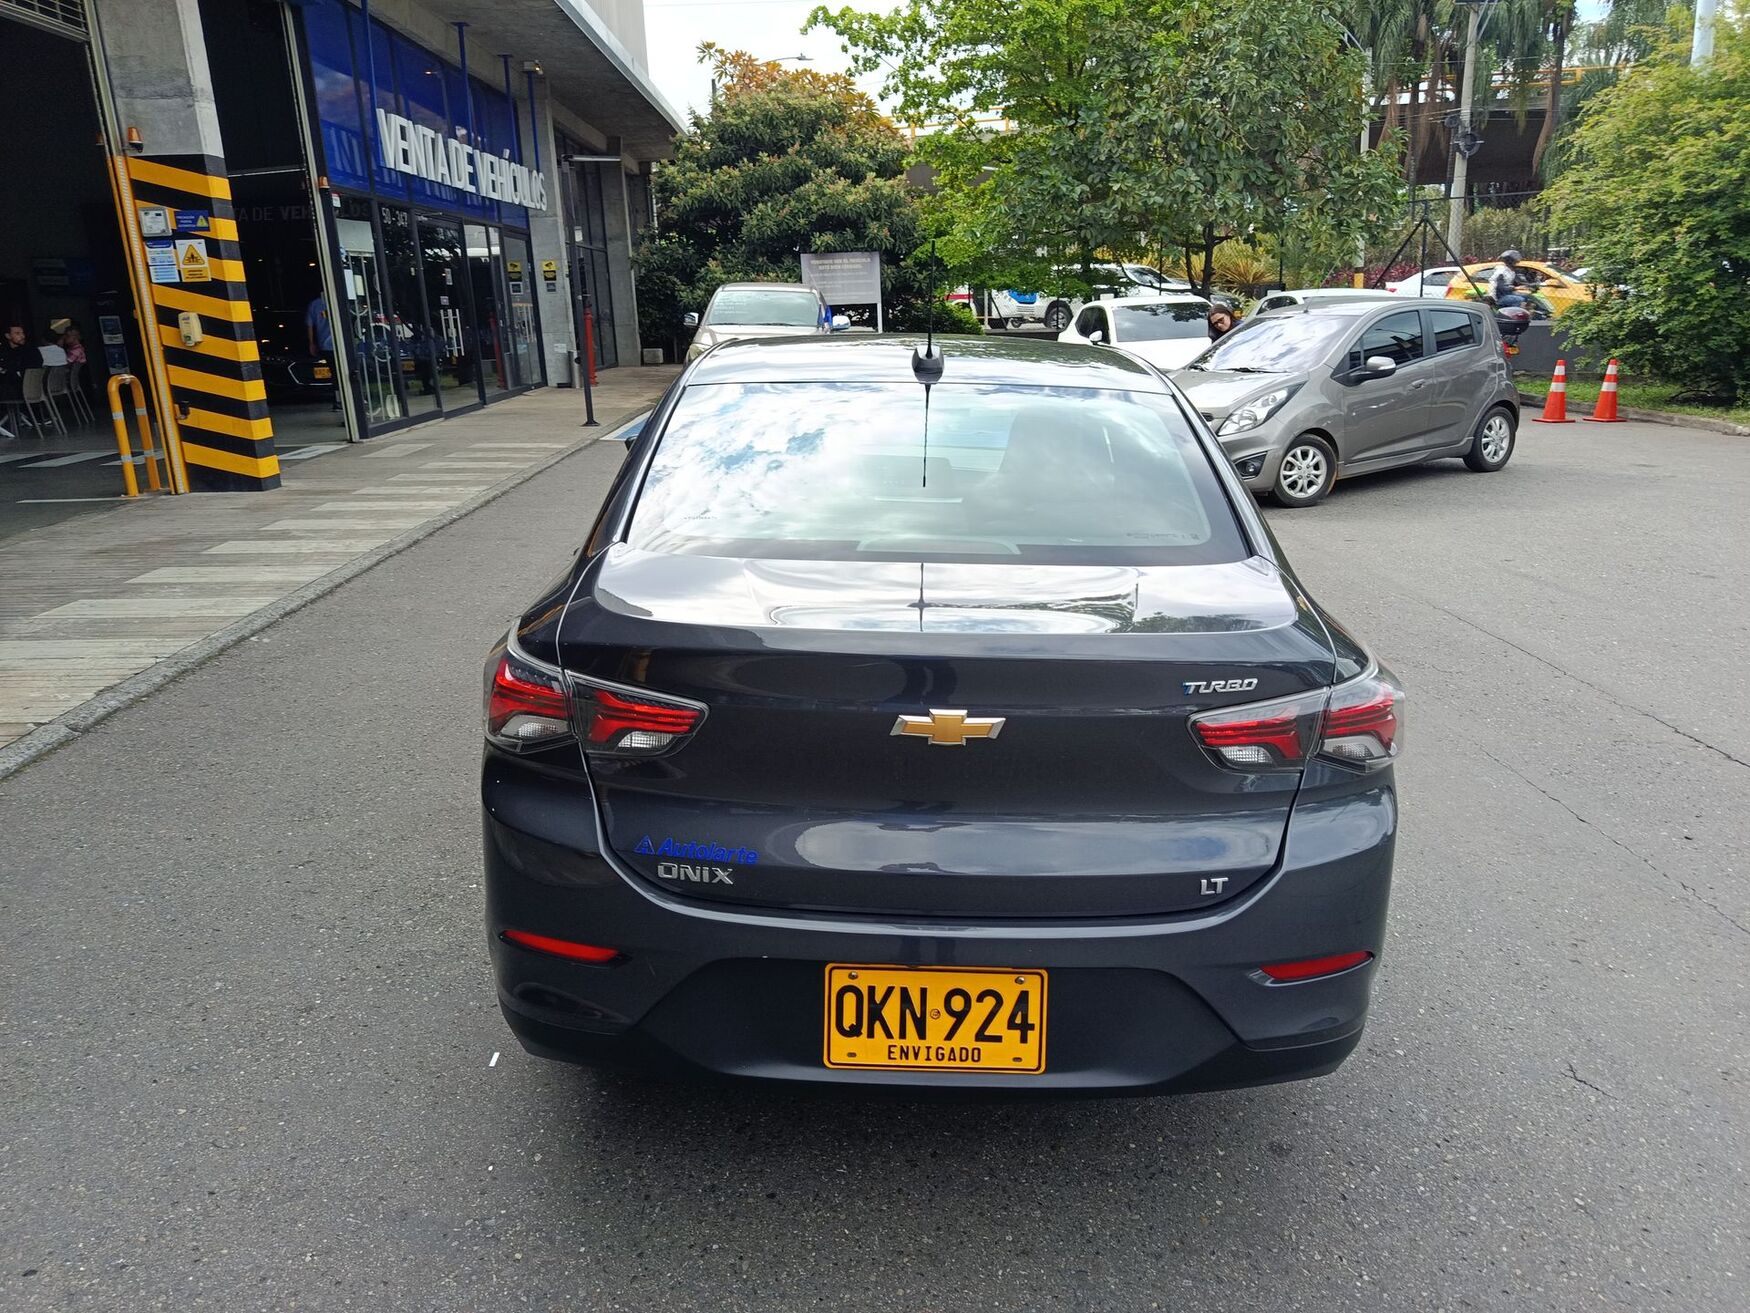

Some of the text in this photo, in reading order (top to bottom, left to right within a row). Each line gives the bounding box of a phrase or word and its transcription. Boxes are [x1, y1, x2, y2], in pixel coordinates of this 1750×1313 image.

[376, 108, 547, 212] VENTA DE VEHÍCULOS
[1183, 678, 1258, 695] TURBO
[657, 837, 760, 864] Autolarte
[657, 862, 734, 885] ONIX
[1200, 877, 1229, 895] LT
[835, 985, 1036, 1044] QKN 924
[887, 1044, 982, 1063] ENVIGADO
